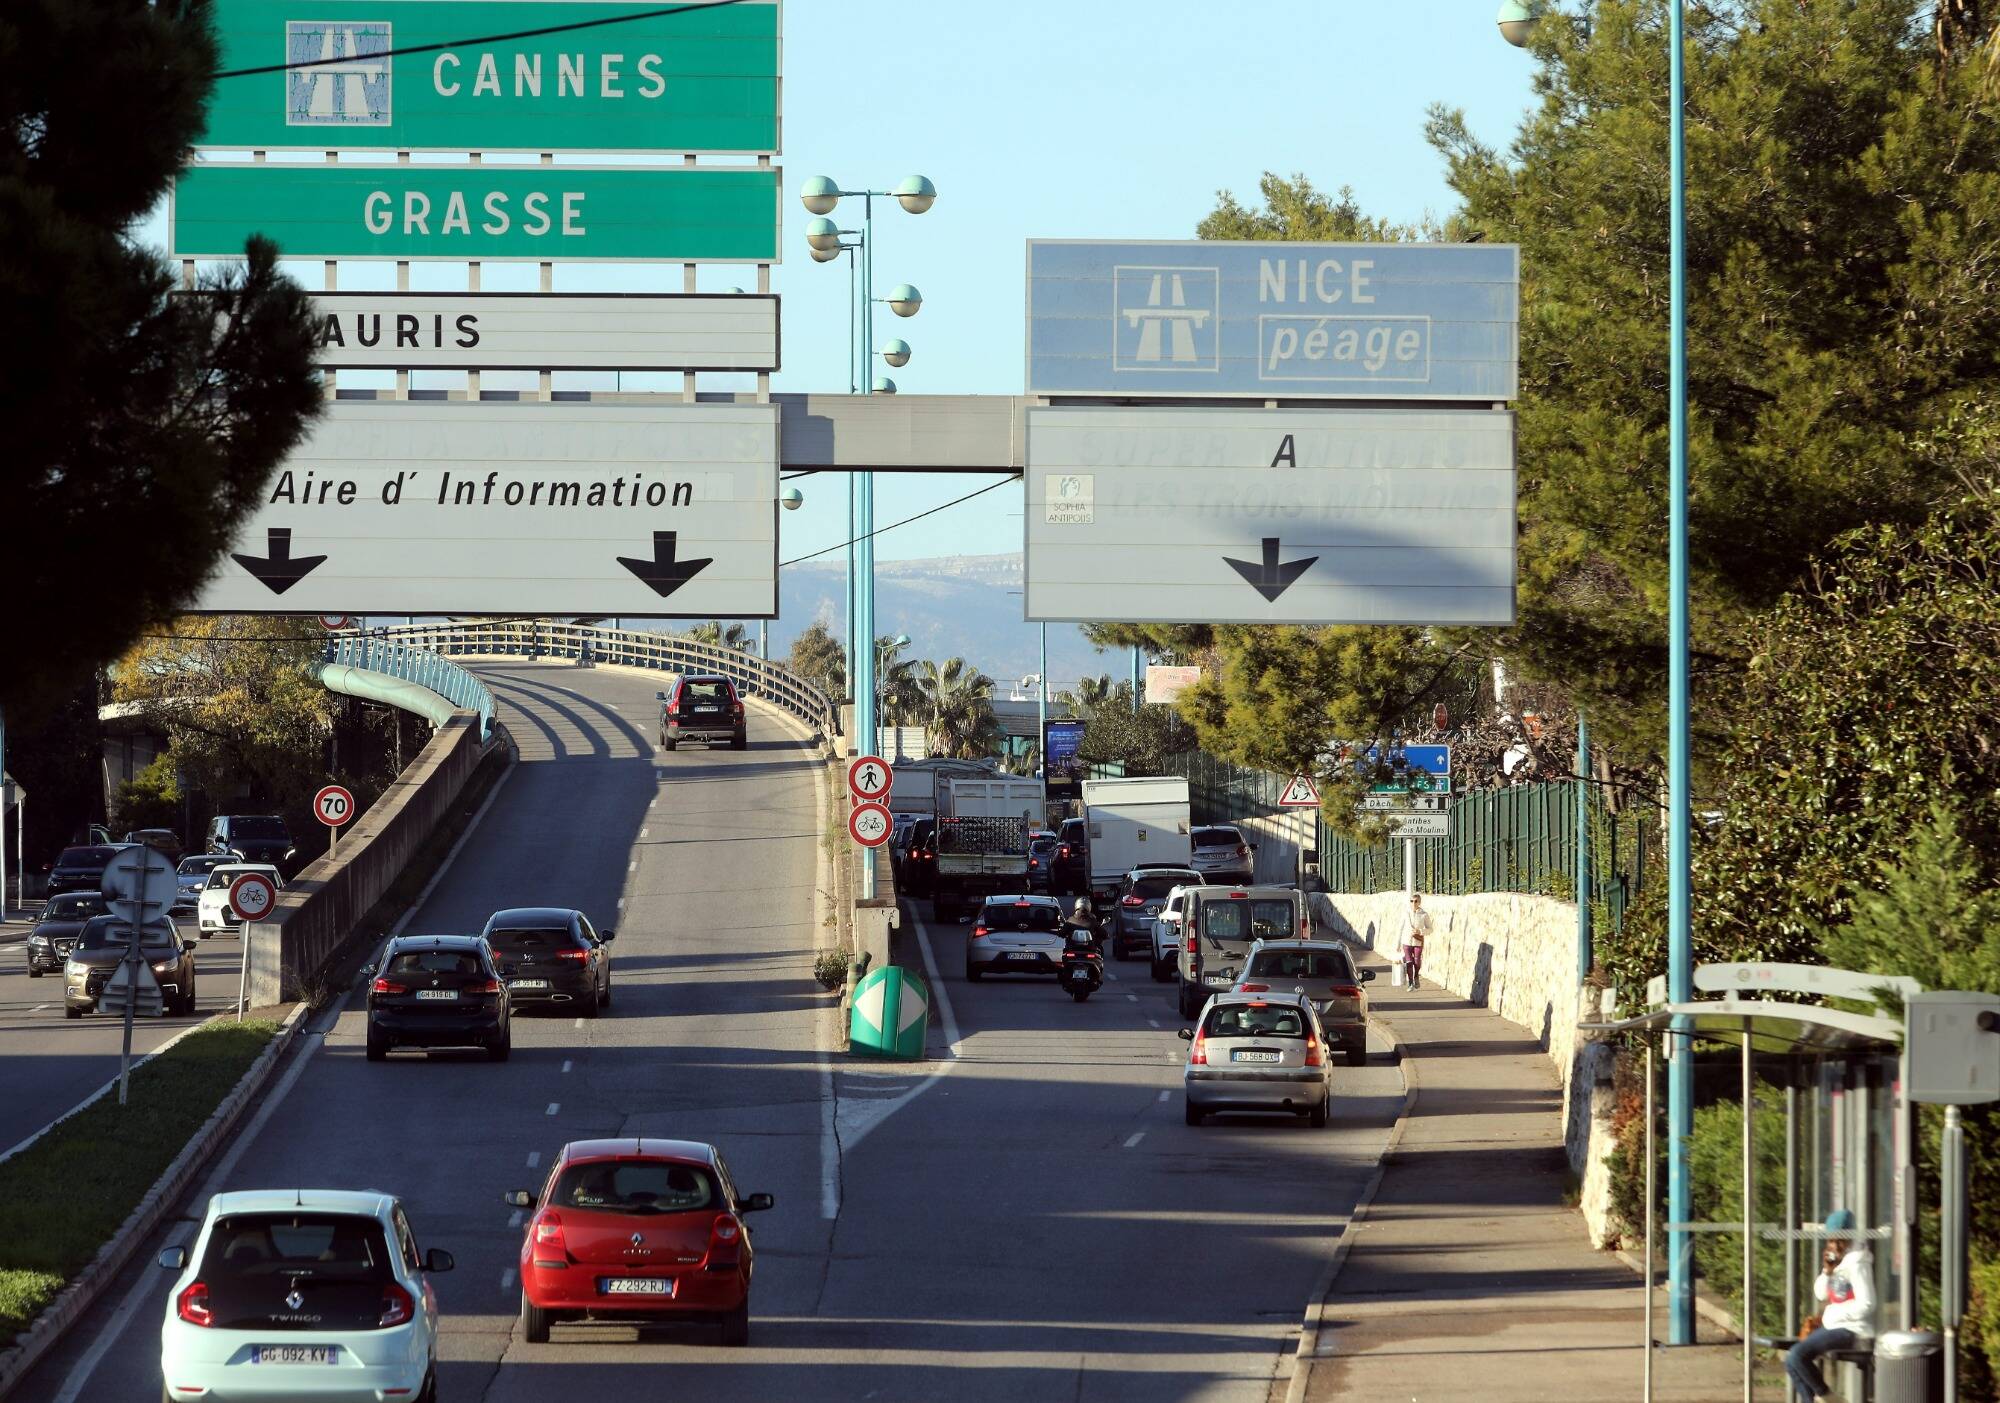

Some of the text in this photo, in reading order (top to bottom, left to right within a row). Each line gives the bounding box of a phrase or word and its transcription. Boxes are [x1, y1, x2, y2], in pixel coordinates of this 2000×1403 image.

[433, 53, 667, 98] CANNES
[364, 191, 586, 236] GRASSE
[1259, 259, 1375, 304] NICE
[322, 313, 480, 348] AURIS
[1268, 319, 1421, 372] péage
[269, 470, 358, 505] Aire
[438, 471, 695, 507] Information
[1054, 502, 1087, 511] SOPHIA
[1047, 514, 1092, 523] ANTIPOLIS
[323, 797, 346, 815] 70
[268, 1314, 322, 1323] TWINGO
